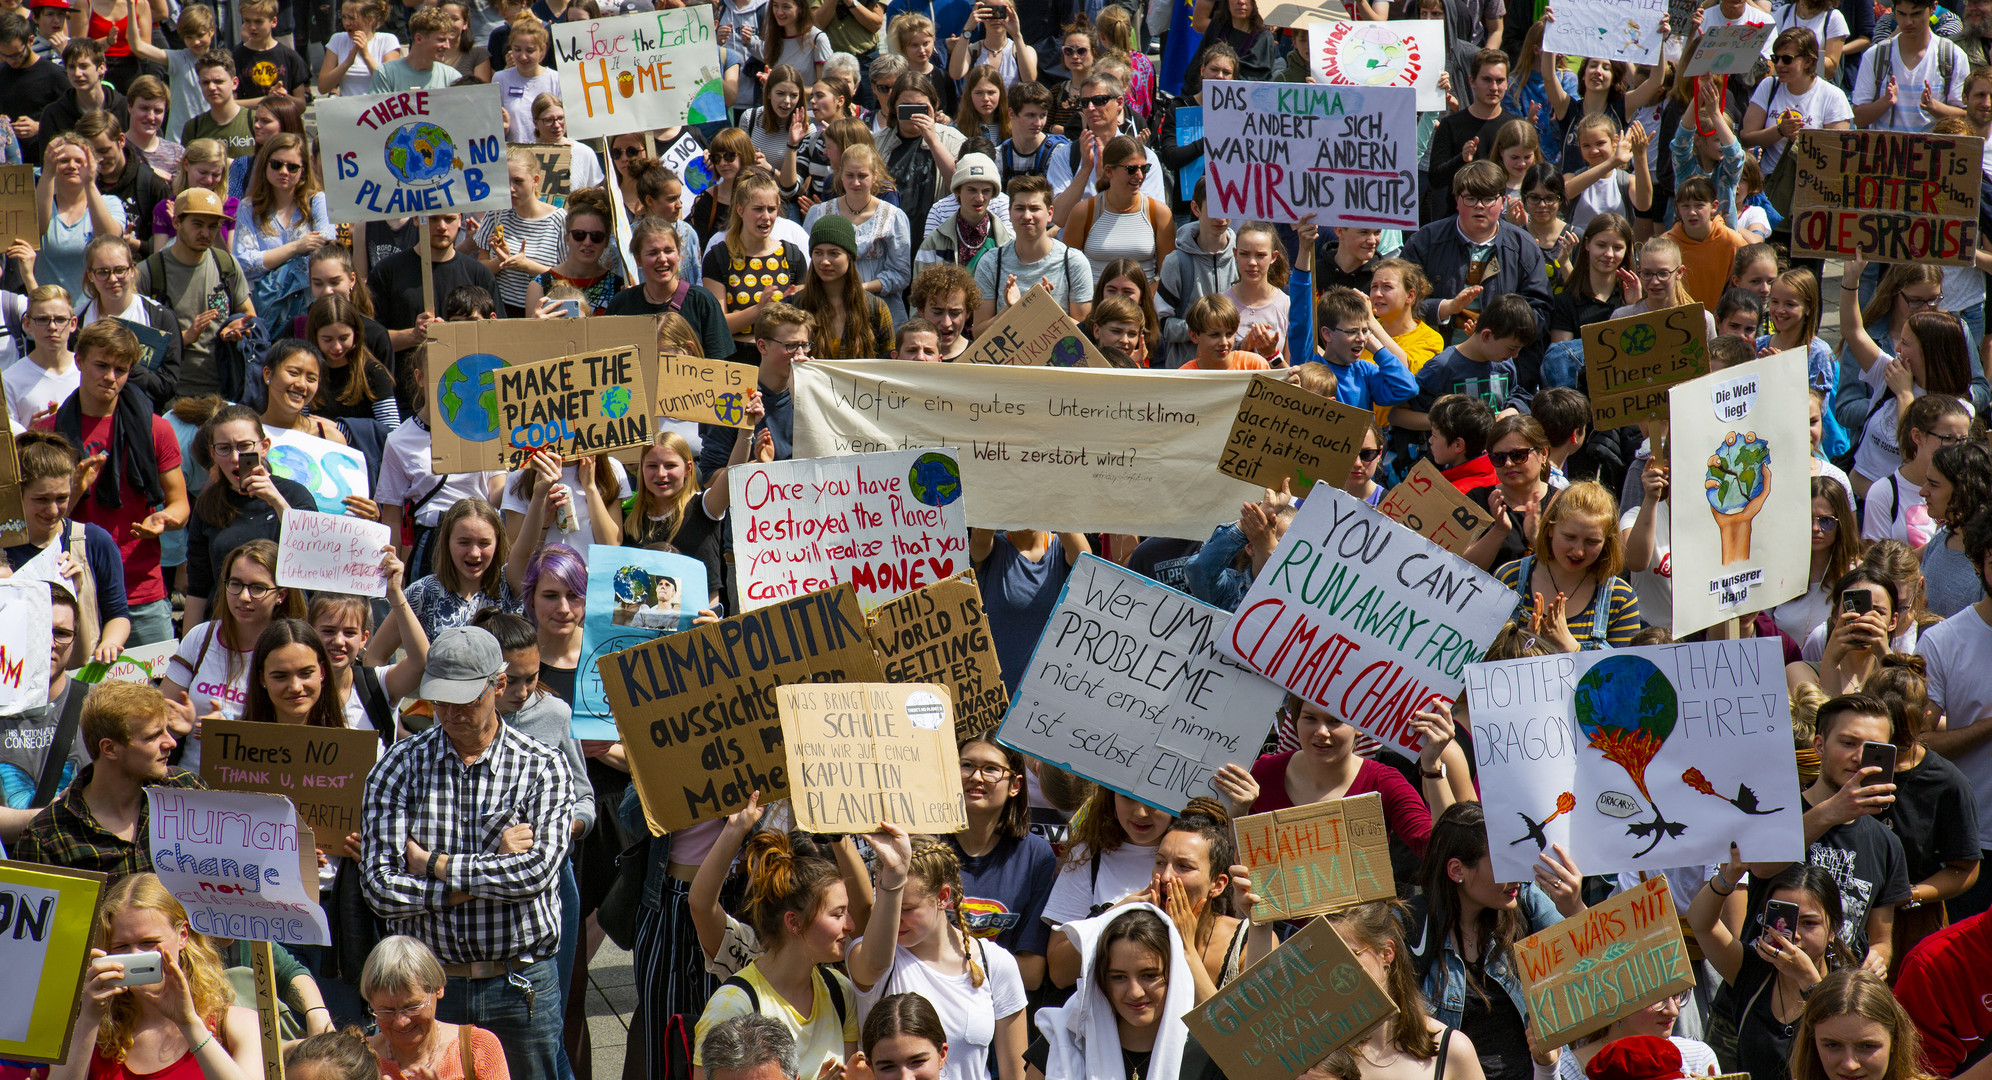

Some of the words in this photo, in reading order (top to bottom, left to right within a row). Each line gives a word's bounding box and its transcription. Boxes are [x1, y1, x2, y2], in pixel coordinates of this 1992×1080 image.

[556, 36, 583, 63] We
[585, 22, 628, 60] Love
[632, 28, 656, 52] the
[657, 8, 709, 49] Earth
[634, 56, 641, 67] is
[649, 53, 667, 64] our
[356, 91, 430, 131] THERE
[1212, 85, 1247, 111] DAS
[1277, 87, 1345, 115] KLIMA
[229, 135, 256, 148] Klein
[1242, 112, 1321, 139] ÄNDERT
[1338, 112, 1388, 142] SICH,
[336, 151, 360, 181] IS
[468, 134, 500, 165] NO
[674, 136, 697, 161] NO
[1204, 137, 1290, 164] WARUM
[1314, 137, 1398, 170] ÄNDERN
[1800, 133, 1828, 170] this
[1840, 132, 1956, 181] PLANET
[1949, 152, 1968, 176] is
[355, 178, 455, 214] PLANET
[463, 167, 491, 202] B
[1209, 161, 1299, 221] WIR
[1289, 170, 1334, 209] UNS
[1345, 170, 1416, 216] NICHT?
[1799, 168, 1842, 208] getting
[1842, 174, 1941, 215] HOTTER
[1938, 176, 1974, 209] than
[501, 356, 574, 402] MAKE
[582, 351, 633, 386] THE
[661, 355, 714, 383] Time
[724, 369, 741, 386] is
[1596, 363, 1662, 390] There
[1671, 354, 1689, 371] is
[503, 389, 595, 430] PLANET
[657, 388, 716, 416] running
[830, 377, 910, 421] Wofür
[924, 396, 953, 413] ein
[969, 393, 1025, 421] gutes
[1048, 397, 1200, 427] Unterrichtsklima,
[1247, 379, 1345, 426] Dinosaurier
[1596, 405, 1616, 420] no
[1715, 388, 1731, 404] Die
[1733, 381, 1756, 398] Welt
[1724, 401, 1747, 418] liegt
[510, 417, 576, 449] COOL
[571, 414, 647, 454] AGAIN
[1230, 428, 1257, 449] sie
[1261, 434, 1320, 468] hätten
[1237, 406, 1310, 441] dachten
[1312, 432, 1351, 455] auch
[834, 438, 887, 453] wenn
[972, 439, 1010, 461] Welt
[1020, 443, 1088, 467] zerstört
[1097, 447, 1137, 468] wird?
[1219, 449, 1263, 480] Zeit
[745, 469, 804, 511] Once
[811, 478, 850, 504] you
[857, 465, 901, 495] have
[1408, 470, 1432, 497] IS
[288, 511, 320, 538] Why
[320, 517, 337, 534] sit
[340, 521, 351, 536] in
[747, 508, 849, 544] destroyed
[851, 501, 883, 530] the
[887, 494, 948, 530] Planet,
[1452, 506, 1479, 531] B
[281, 553, 318, 580] future
[284, 531, 342, 562] learning
[347, 538, 365, 561] for
[371, 549, 380, 559] a
[747, 545, 782, 577] you
[786, 541, 821, 564] will
[824, 538, 883, 561] realize
[890, 531, 933, 558] that
[936, 537, 966, 558] you
[1322, 499, 1393, 565] YOU
[1396, 553, 1482, 614] CAN'T
[747, 569, 798, 600] can't
[802, 565, 840, 593] eat
[1085, 566, 1148, 621] Wer
[1710, 580, 1719, 592] in
[1721, 569, 1762, 588] unserer
[1721, 587, 1747, 604] Hand
[883, 588, 934, 627] THIS
[1269, 539, 1360, 617] RUN
[1340, 585, 1430, 652] AWAY
[1414, 623, 1486, 684] FROM
[617, 588, 863, 708] KLIMAPOLITIK
[877, 611, 952, 658] WORLD
[959, 598, 981, 626] IS
[106, 662, 135, 680] SIND
[143, 654, 165, 670] WIR
[885, 628, 989, 683] GETTING
[1056, 610, 1224, 711] PROBLEME
[1232, 598, 1361, 708] CLIMATE
[1340, 660, 1455, 753] CHANGE
[958, 675, 982, 701] MY
[1468, 657, 1577, 710] HOTTER
[1659, 642, 1760, 691] THAN
[870, 690, 893, 710] UNS
[1040, 661, 1104, 698] nicht
[1106, 691, 1169, 724] ernst
[1172, 715, 1240, 753] nimmt,
[4, 728, 18, 737] THIS
[20, 728, 43, 738] ACTION
[215, 733, 292, 764] There's
[305, 740, 339, 766] NO
[1025, 701, 1066, 737] ist
[1069, 728, 1144, 767] selbst
[1473, 715, 1578, 767] DRAGON
[1682, 693, 1777, 739] FIRE!
[701, 735, 745, 771] als
[214, 765, 270, 785] 'THANK
[281, 774, 295, 789] U,
[303, 774, 354, 789] NEXT'
[682, 764, 787, 820] Mathe
[801, 762, 902, 789] KAPUTTEN
[155, 793, 298, 851] Human
[299, 803, 354, 830] EARTH
[1600, 794, 1636, 812] DRACARYS
[1244, 818, 1341, 867] WÄHLT
[1368, 821, 1382, 836] das
[155, 843, 280, 893] change
[1250, 851, 1382, 916] KLIMA
[174, 891, 310, 915] climate
[199, 882, 246, 896] not
[191, 907, 303, 943] change
[1520, 939, 1565, 982] WIE
[1568, 910, 1626, 957] WÄRS
[1631, 888, 1668, 930] MIT
[255, 952, 269, 998] SAVE
[1206, 942, 1327, 1035] GLOBAL
[1530, 938, 1690, 1042] KLIMASCHUTZ
[259, 1008, 272, 1041] THE
[1250, 975, 1327, 1037] DENKEN
[1242, 1006, 1333, 1068] LOKAL
[1277, 990, 1384, 1073] HANDELN
